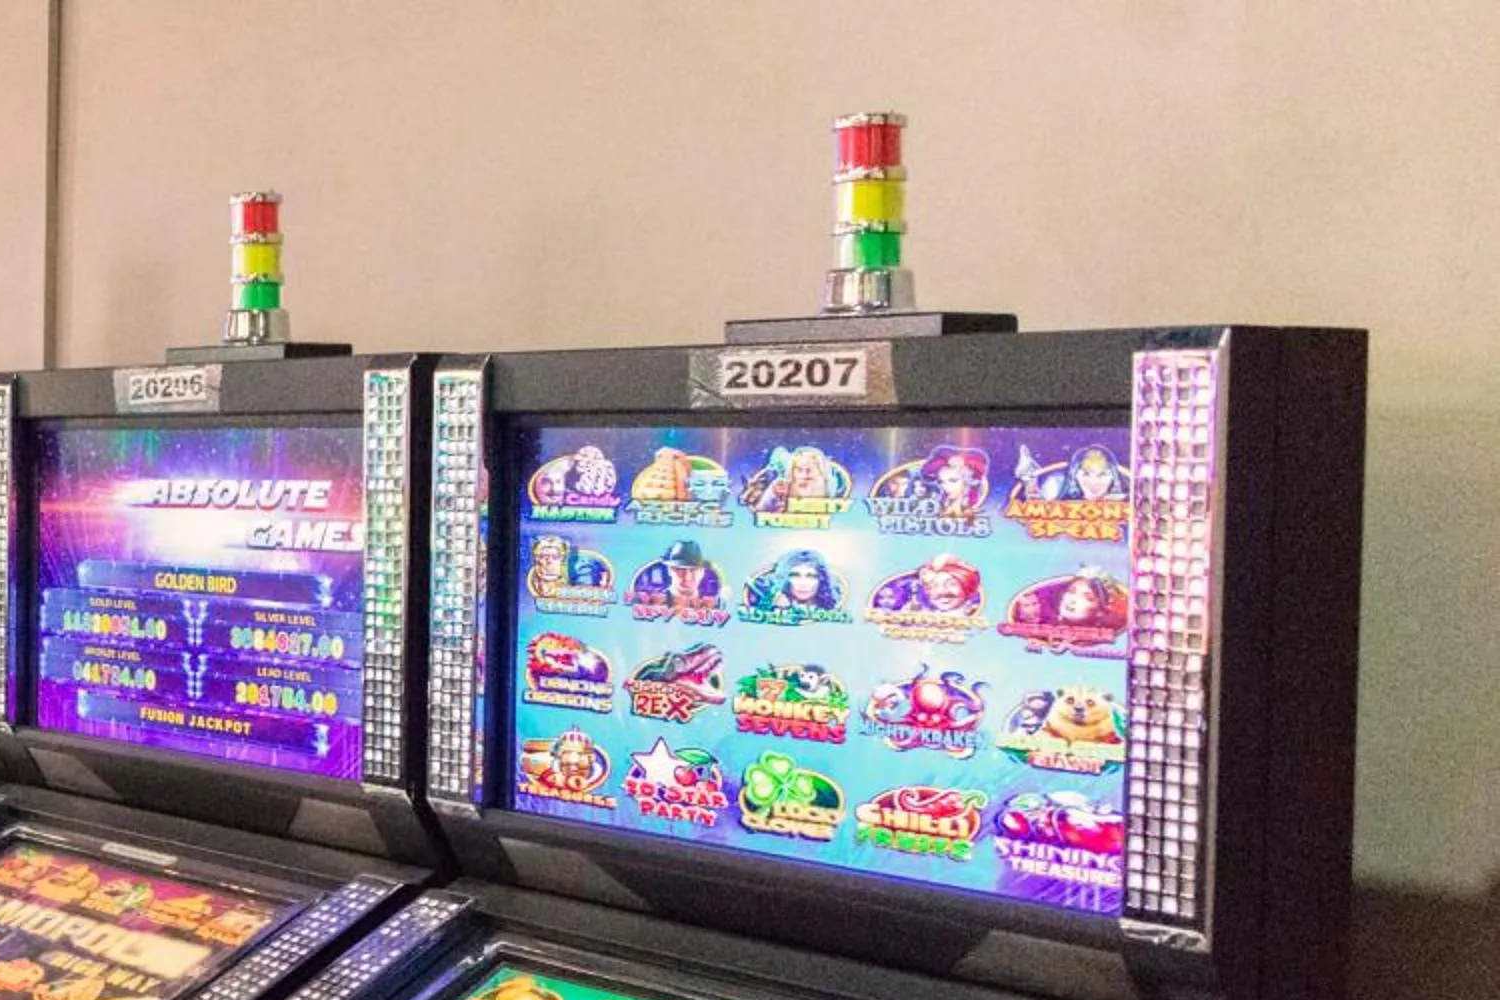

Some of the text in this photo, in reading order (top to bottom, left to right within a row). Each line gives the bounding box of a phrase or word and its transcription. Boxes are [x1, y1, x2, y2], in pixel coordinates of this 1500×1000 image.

[725, 357, 859, 389] 20207
[150, 479, 332, 511] ABSOLUTE
[879, 516, 992, 538] PISTOLS
[154, 572, 237, 595] GOLDEN BIRD
[254, 610, 317, 627] SILVER LEVEL
[284, 670, 311, 684] LEVEL
[139, 706, 253, 736] FUSION JACKPOT
[733, 698, 850, 726] MONKEY
[735, 714, 847, 744] SEVENS
[855, 803, 970, 840] CHILLI
